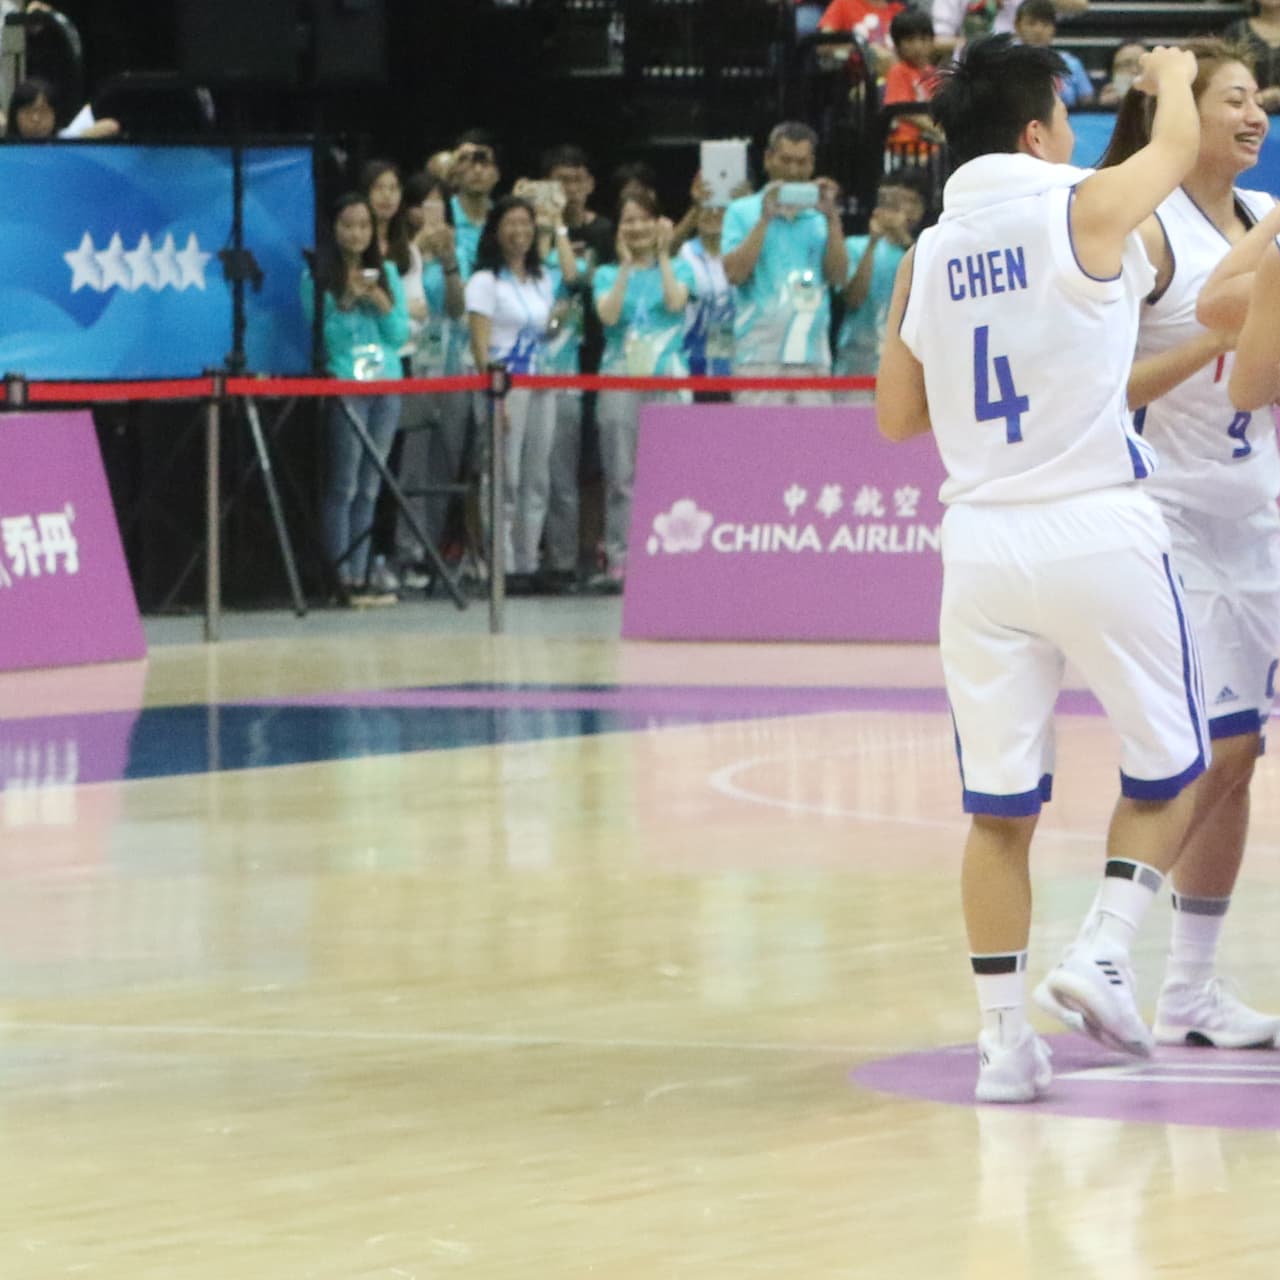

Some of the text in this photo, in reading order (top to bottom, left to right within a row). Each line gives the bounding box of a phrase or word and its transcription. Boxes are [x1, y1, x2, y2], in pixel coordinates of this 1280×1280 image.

[946, 246, 1029, 302] CHEN
[973, 324, 1030, 444] 4
[1227, 411, 1253, 458] 9
[783, 483, 921, 518] 中華航空
[710, 523, 942, 553] CHINA AIRLIN
